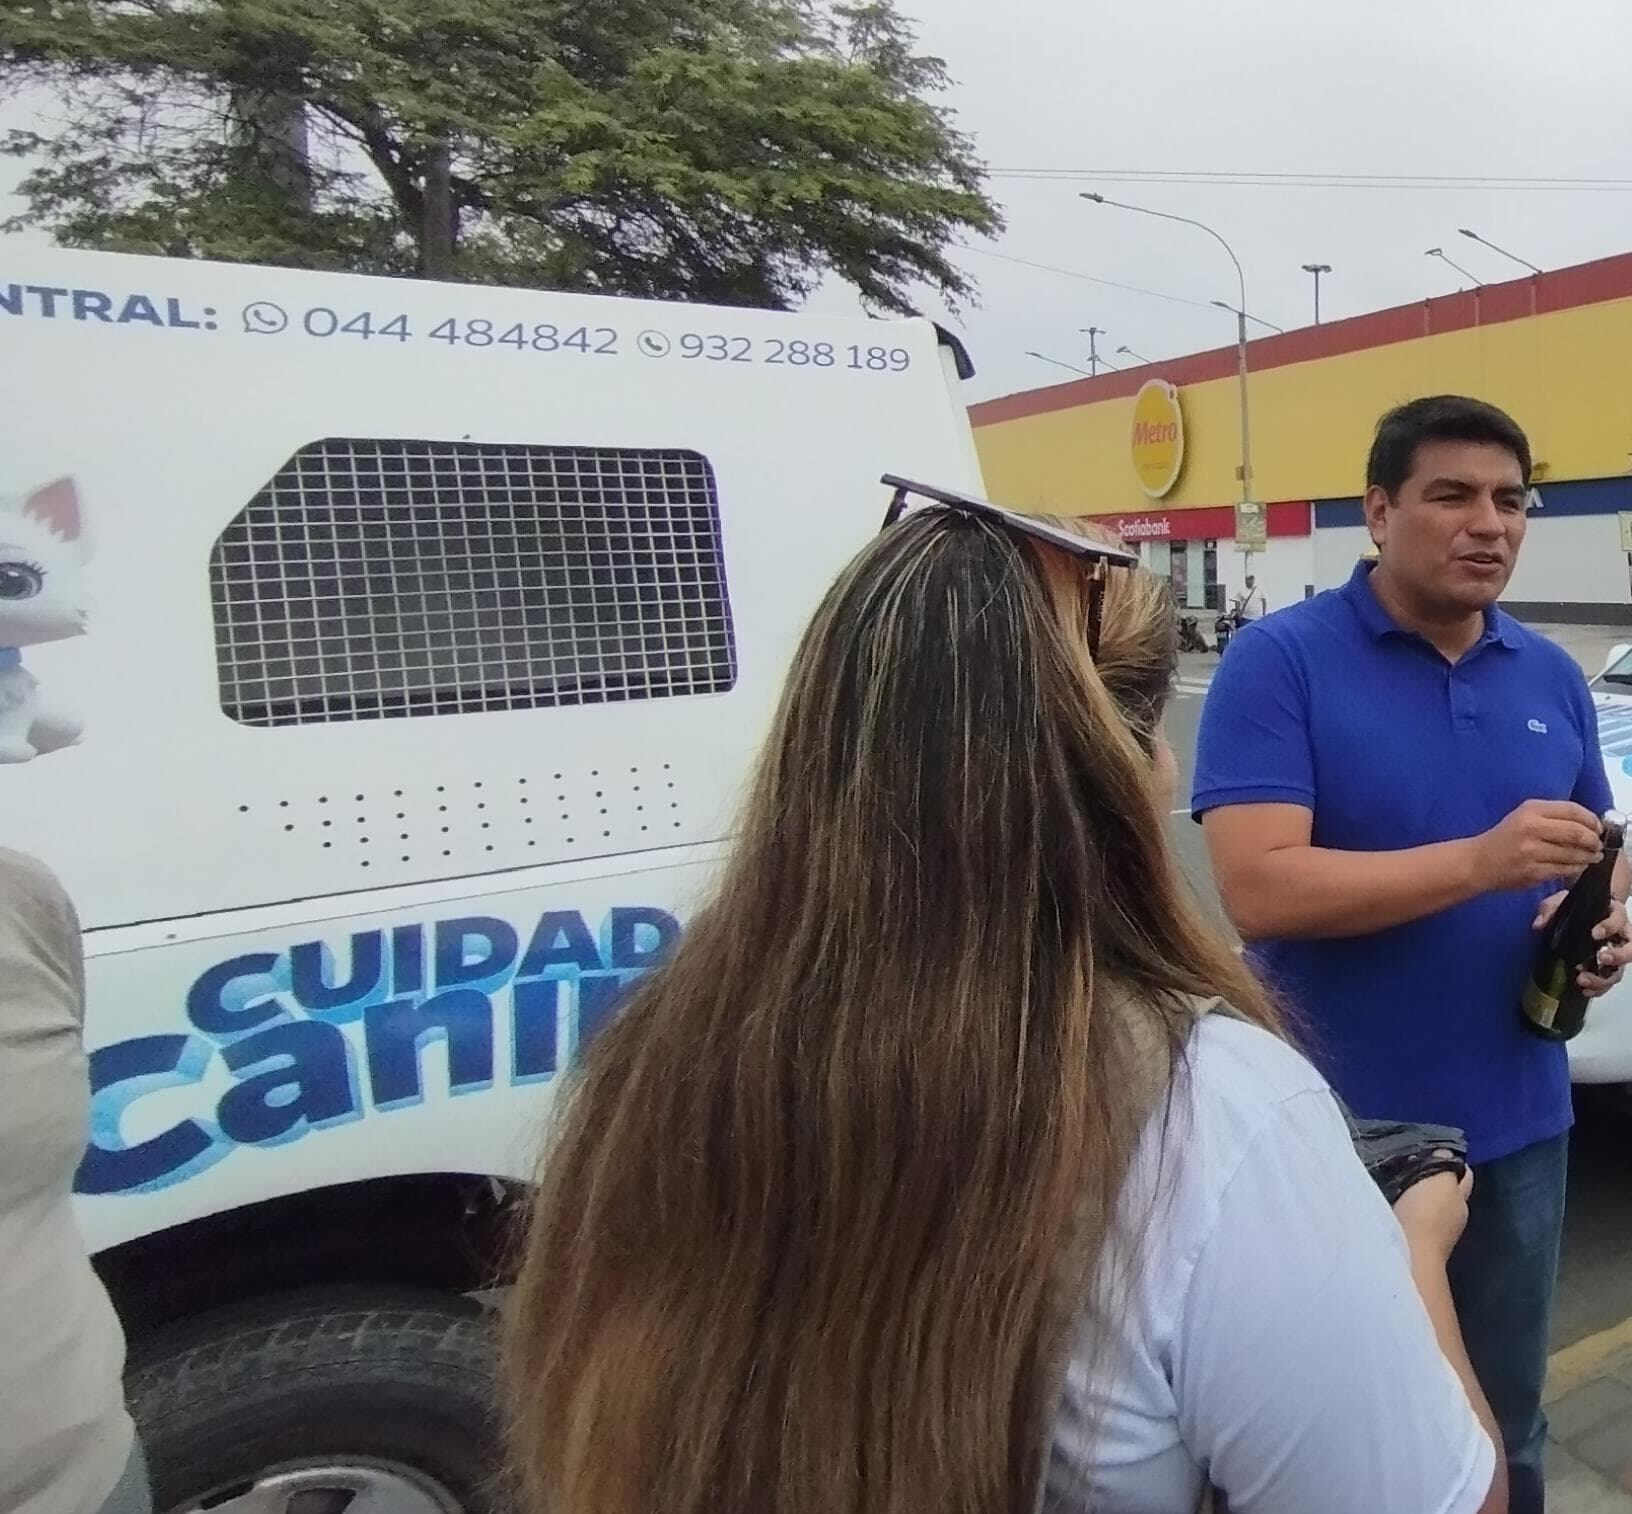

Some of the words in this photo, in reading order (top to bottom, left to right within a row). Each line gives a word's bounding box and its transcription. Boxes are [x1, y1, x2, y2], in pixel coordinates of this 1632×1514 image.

[303, 307, 412, 342] 044
[428, 317, 618, 355] 484842
[680, 333, 752, 361] 932
[764, 339, 835, 367] 288
[847, 345, 910, 371] 189
[1133, 421, 1177, 447] Metro
[1118, 516, 1171, 538] Scotiabank
